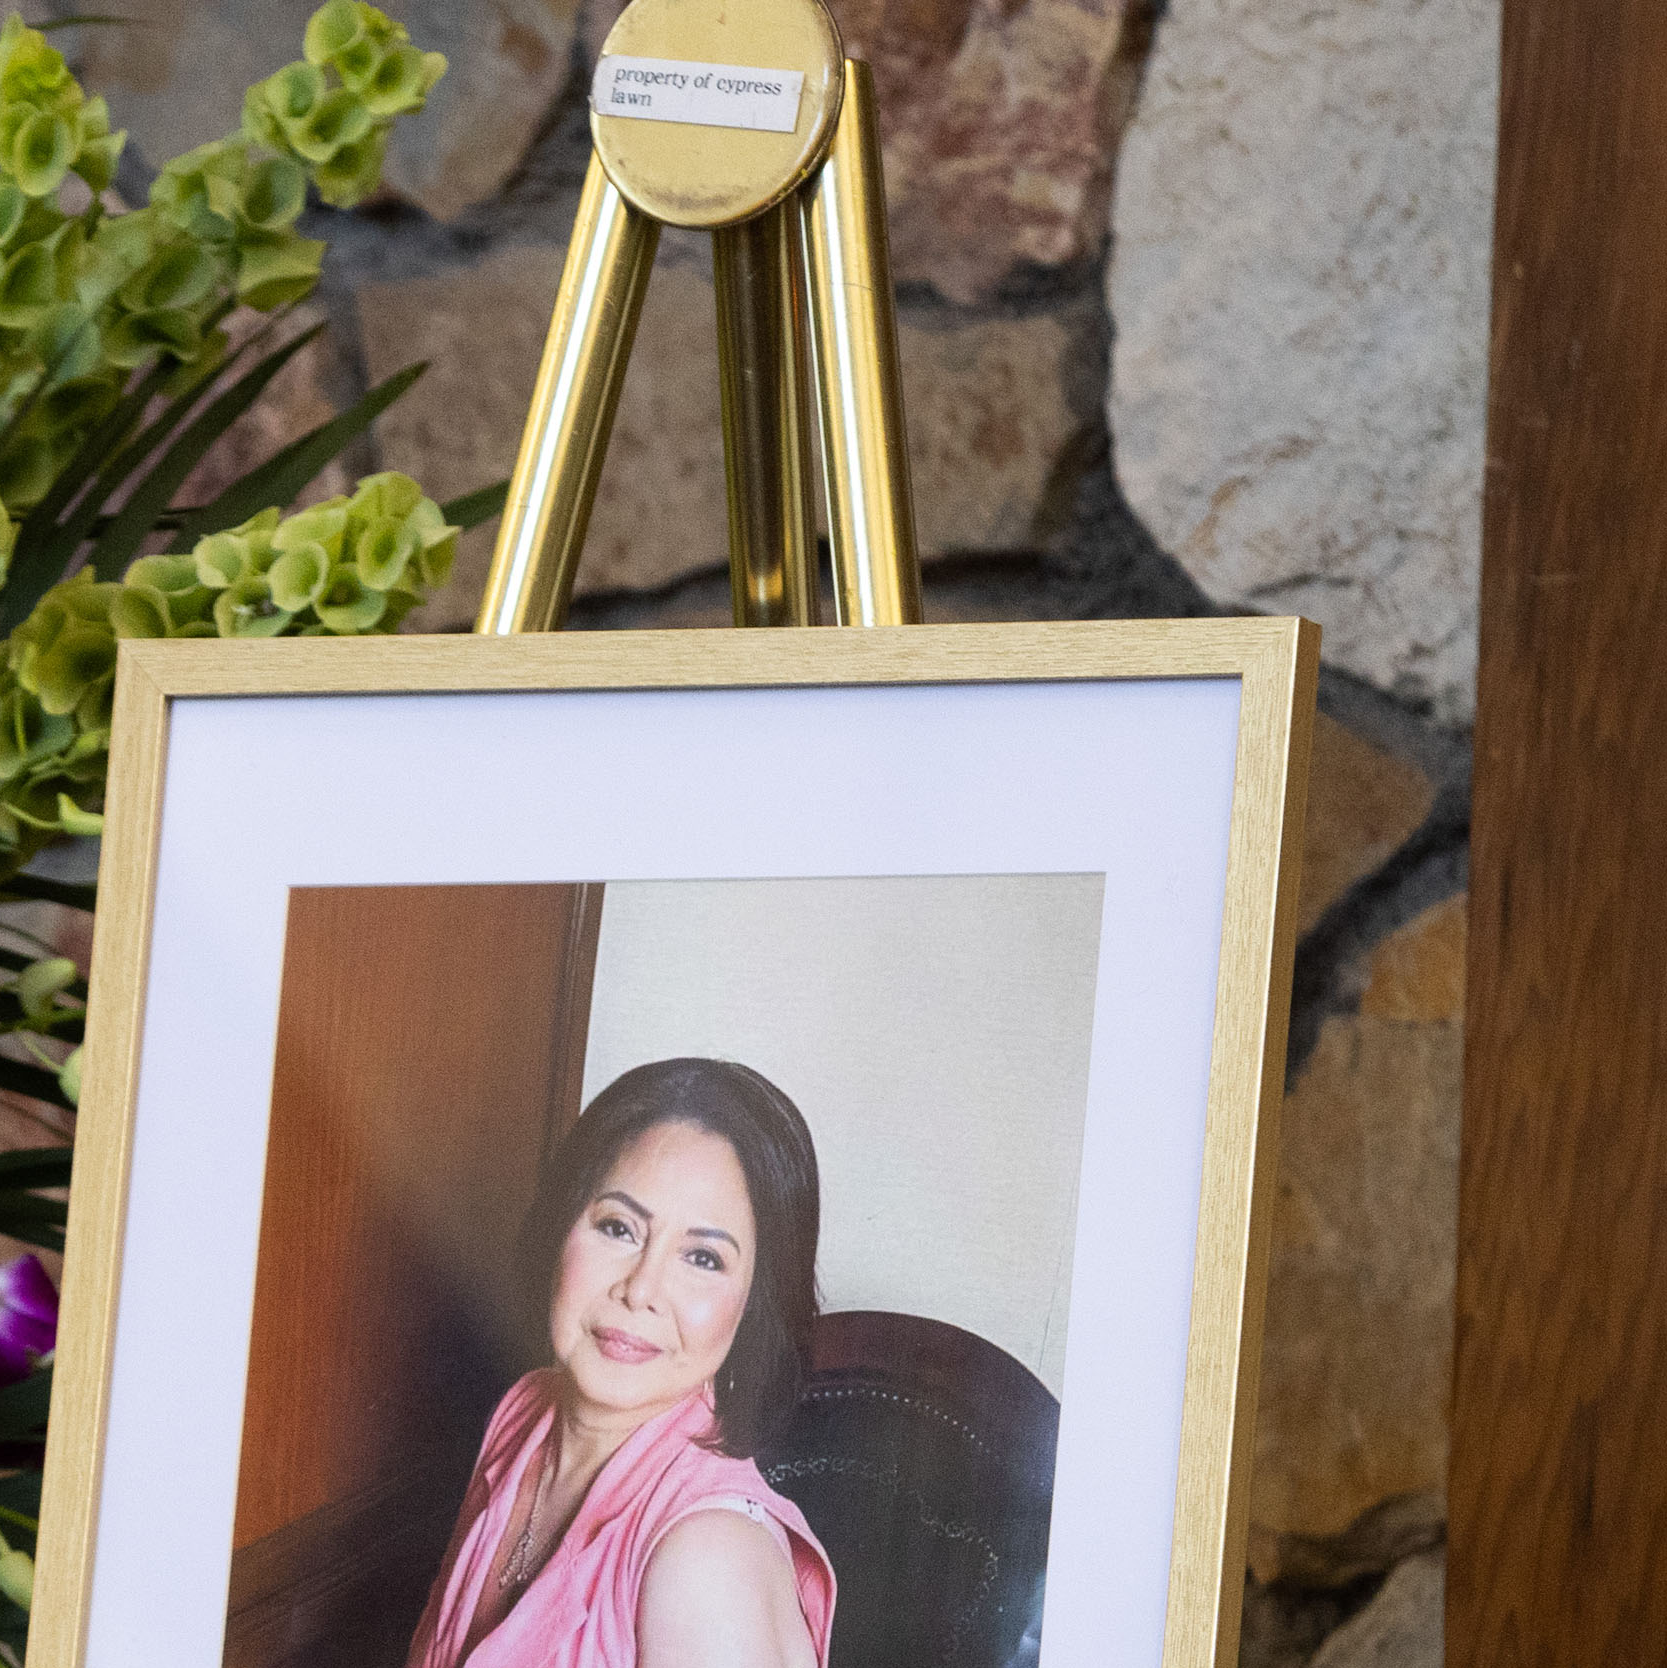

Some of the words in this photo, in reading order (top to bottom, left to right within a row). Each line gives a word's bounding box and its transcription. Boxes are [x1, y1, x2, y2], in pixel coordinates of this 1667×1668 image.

[614, 67, 688, 88] property
[693, 73, 713, 89] of
[716, 77, 782, 96] cypress
[611, 87, 652, 106] lawn
